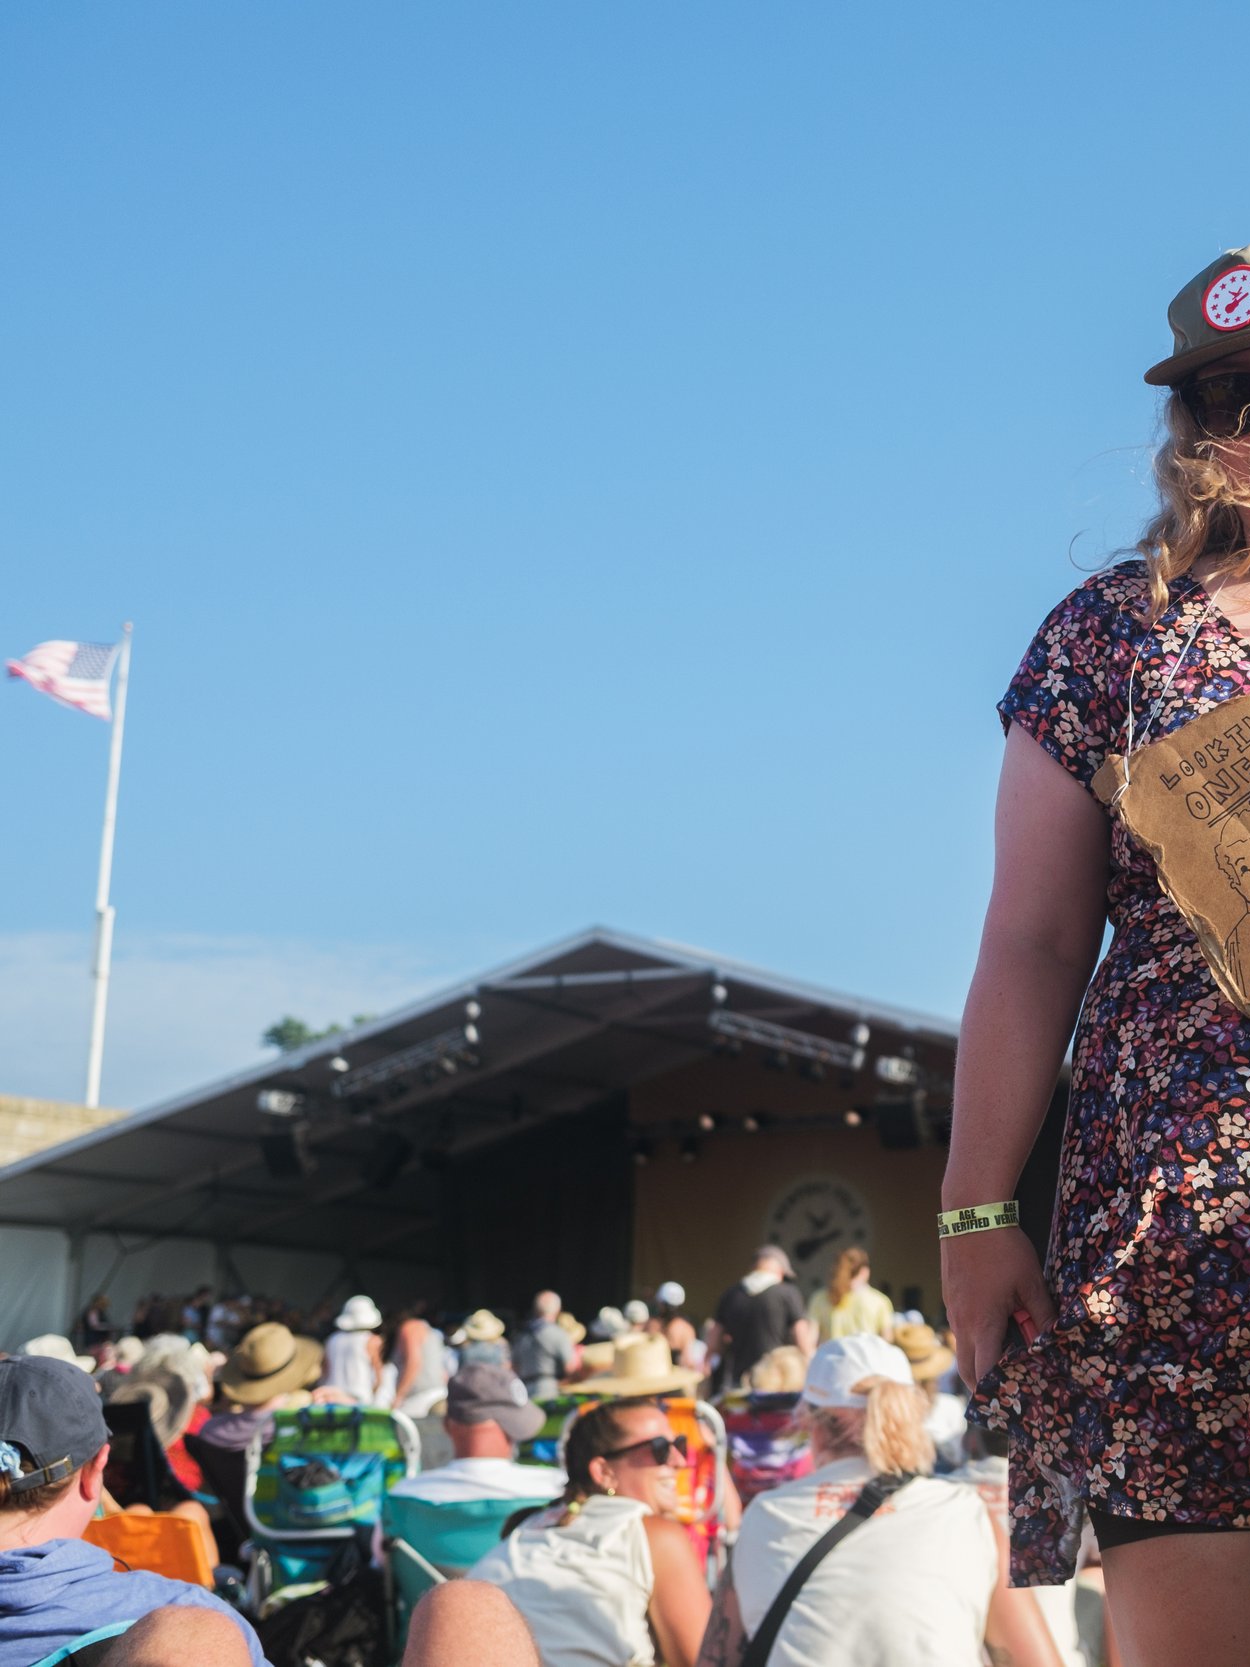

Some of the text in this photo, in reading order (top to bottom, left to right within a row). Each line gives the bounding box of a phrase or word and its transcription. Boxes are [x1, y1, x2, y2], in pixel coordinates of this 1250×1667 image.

[959, 1208, 977, 1221] AGE
[951, 1217, 990, 1233] VERIFIED
[994, 1213, 1019, 1226] VERIF
